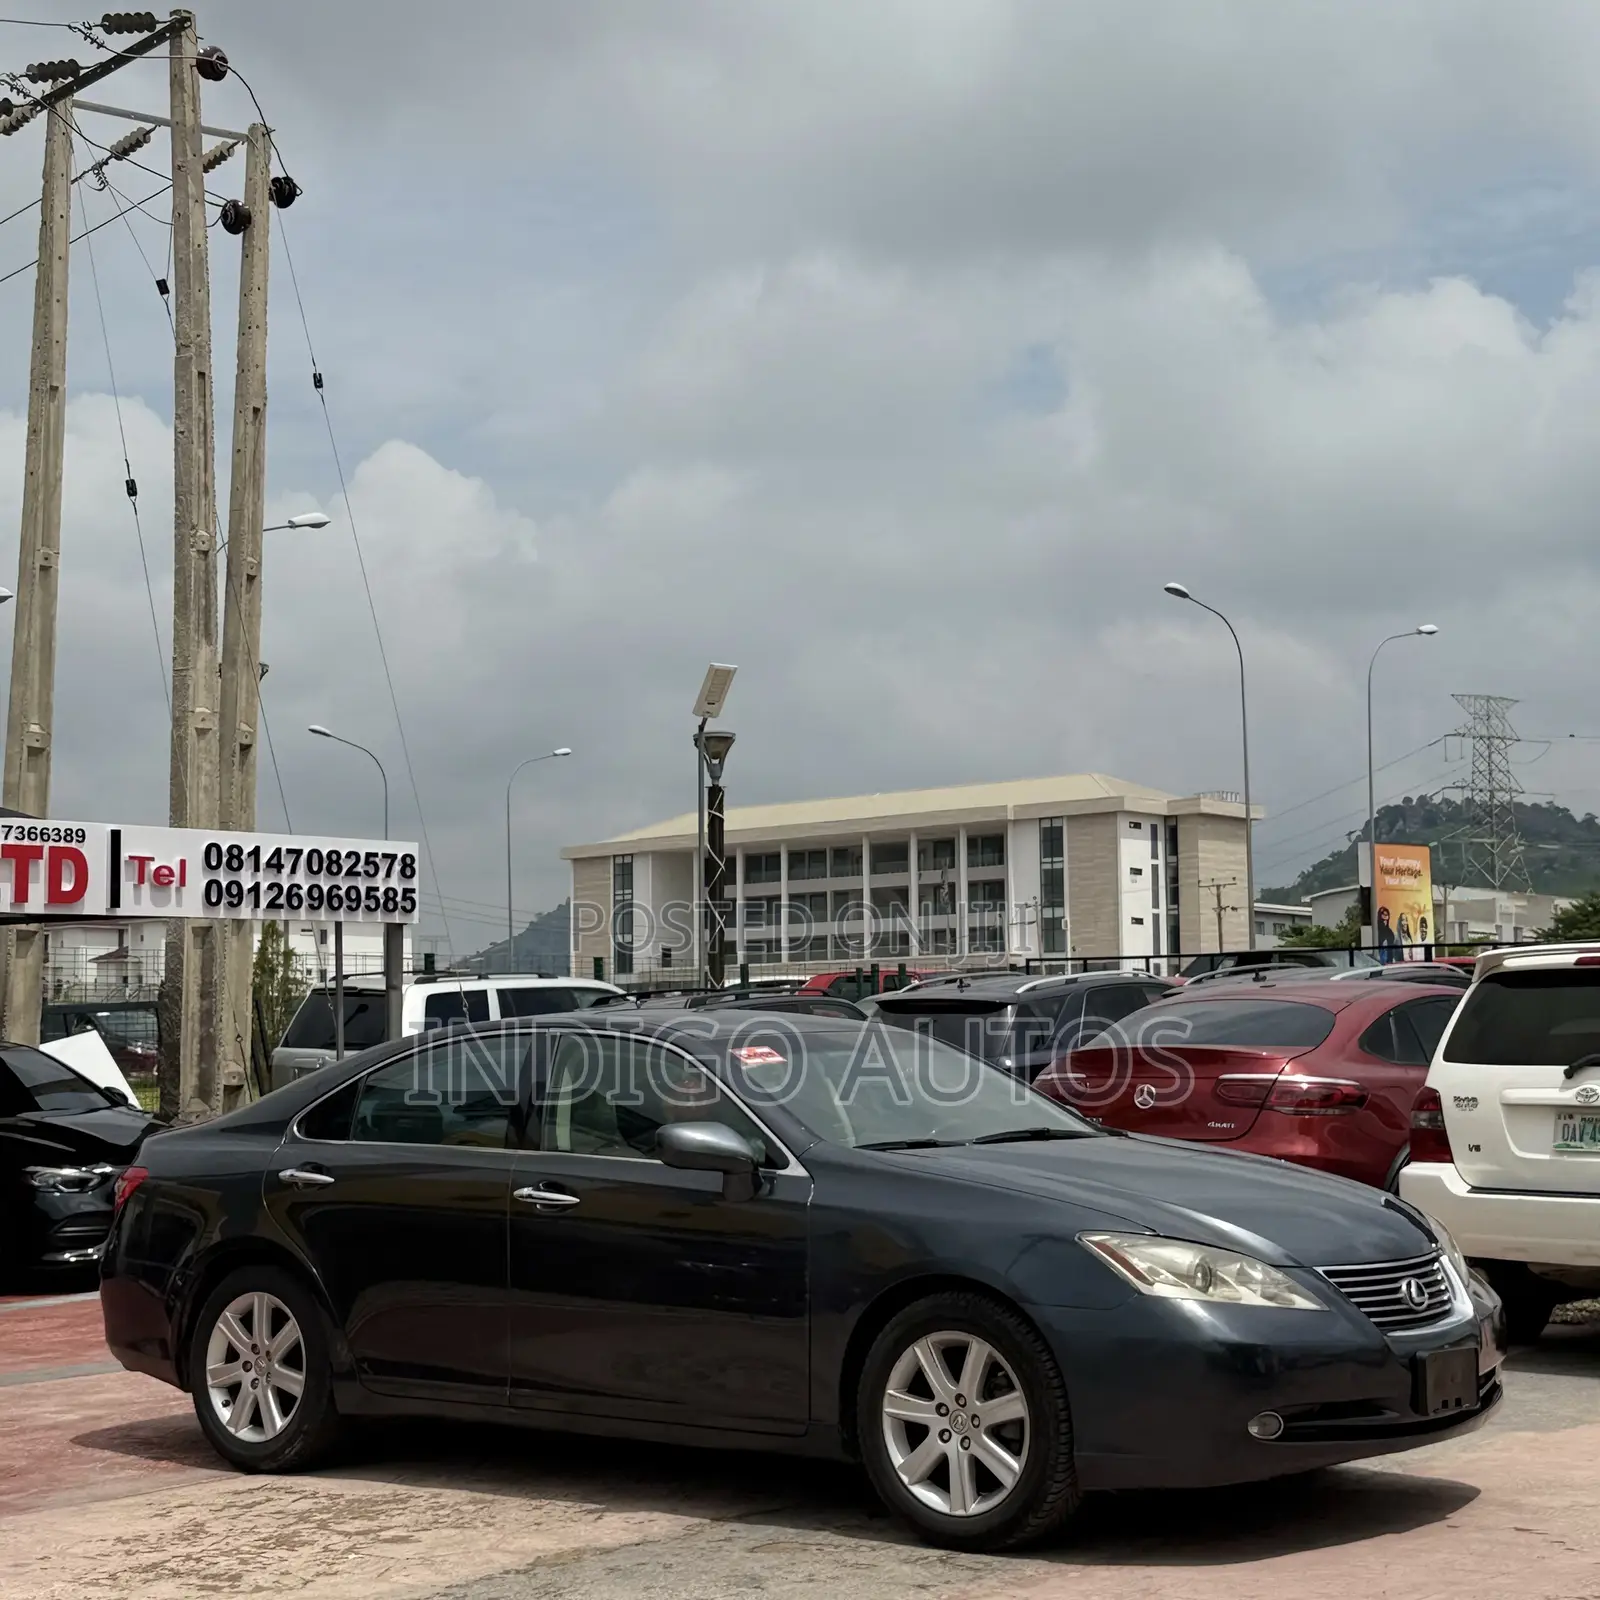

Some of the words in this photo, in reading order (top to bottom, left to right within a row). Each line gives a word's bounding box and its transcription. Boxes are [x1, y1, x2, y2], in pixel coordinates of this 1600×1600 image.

[0, 844, 89, 904] TD
[128, 855, 187, 888] Tel
[204, 842, 416, 880] 08147082578
[204, 878, 417, 914] 09126969585
